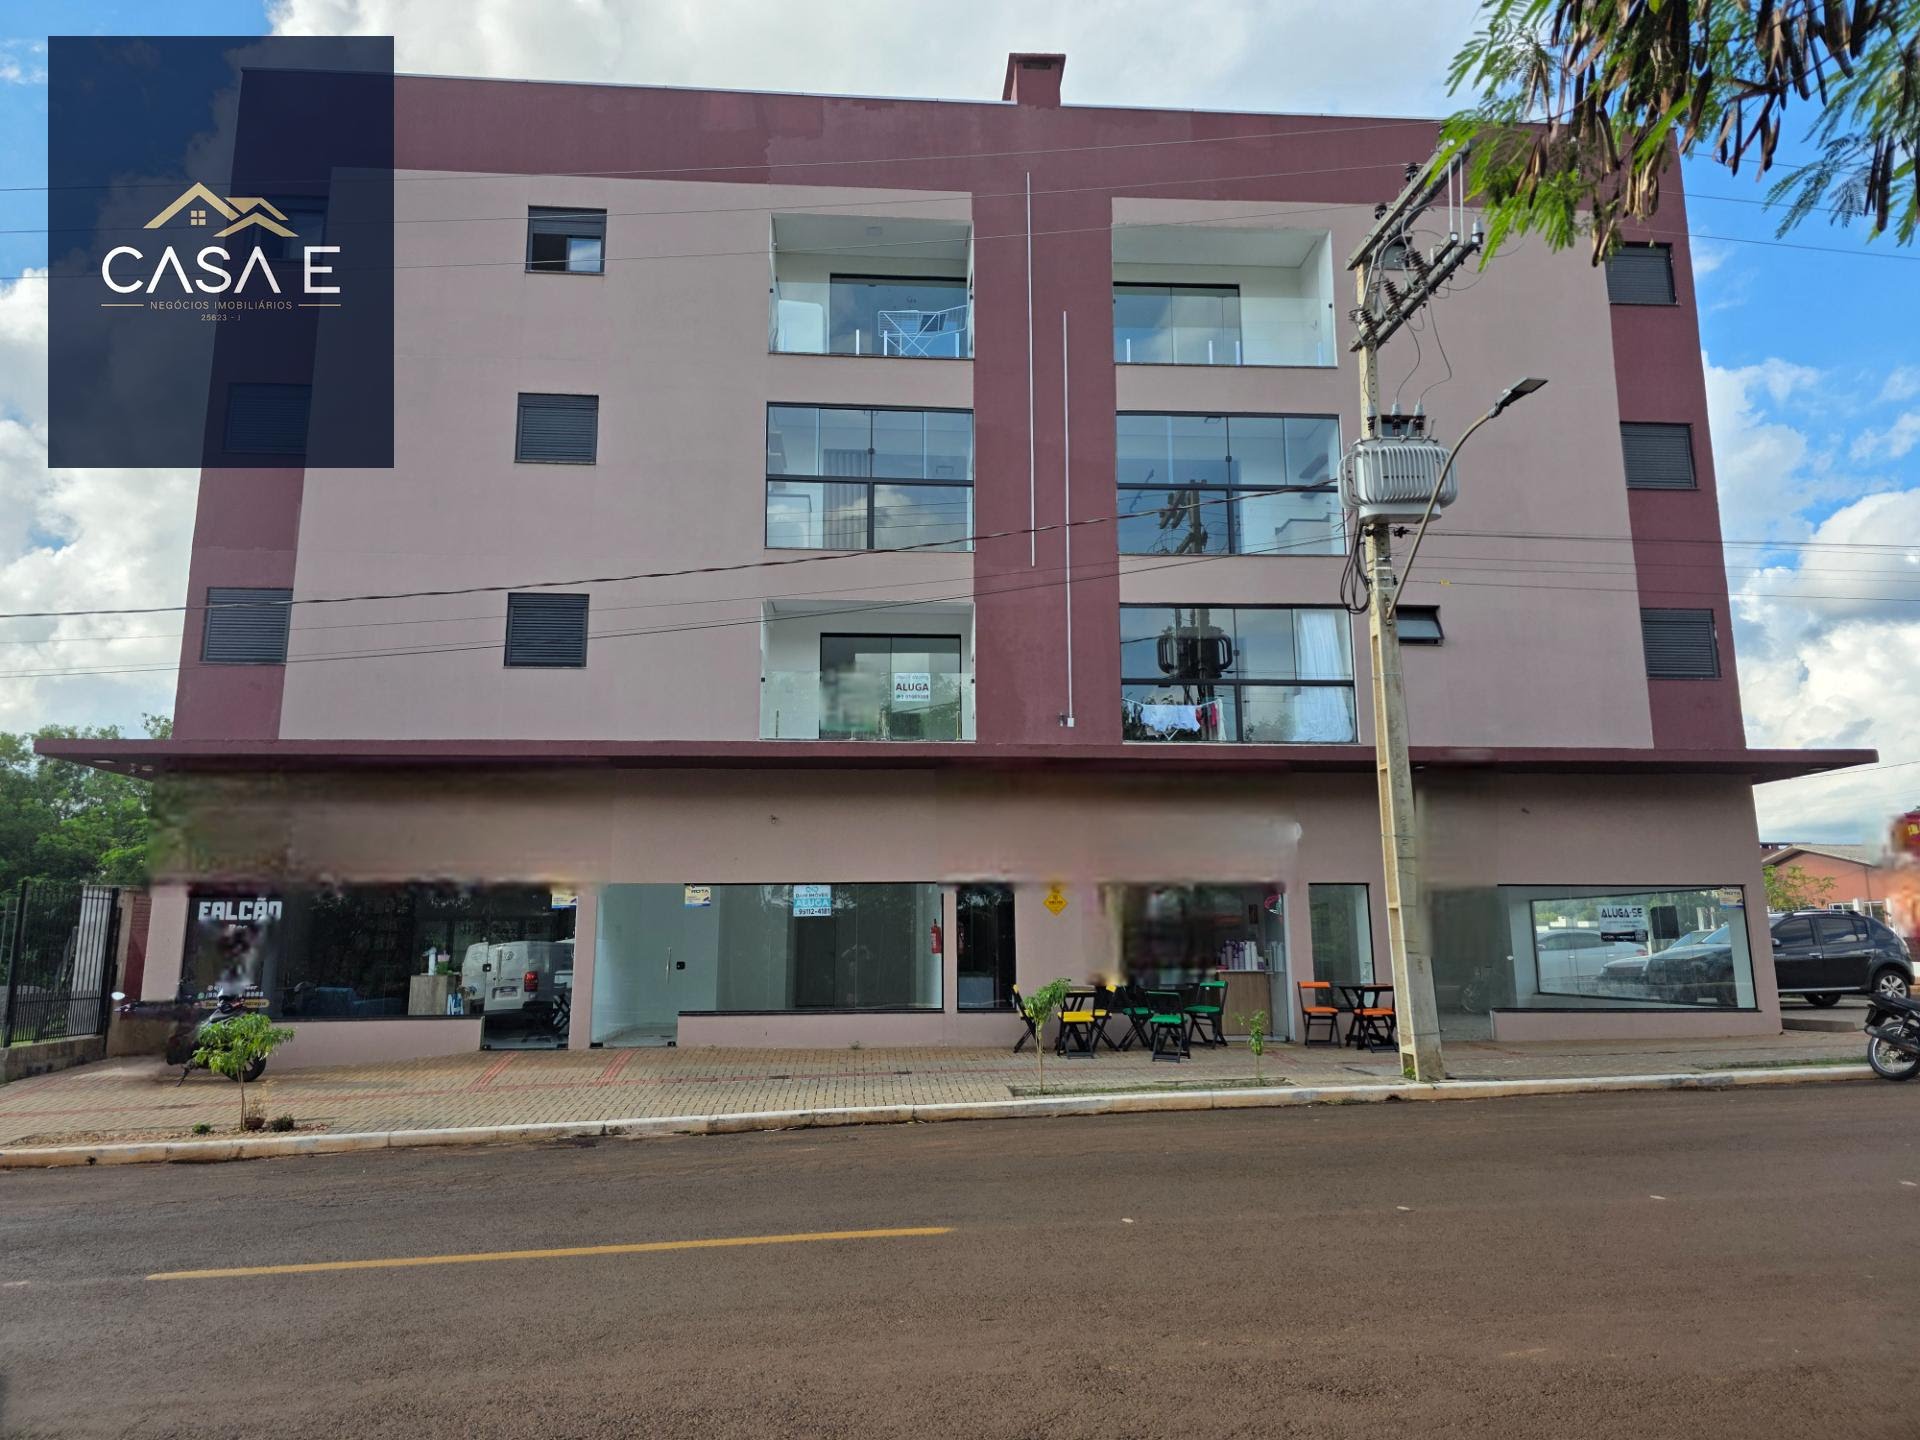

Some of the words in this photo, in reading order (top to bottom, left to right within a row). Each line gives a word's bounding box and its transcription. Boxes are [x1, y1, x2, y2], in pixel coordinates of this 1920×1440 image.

[896, 683, 929, 691] ALUGA
[795, 899, 830, 908] ALUGA
[1601, 907, 1643, 918] ALUGA-SE
